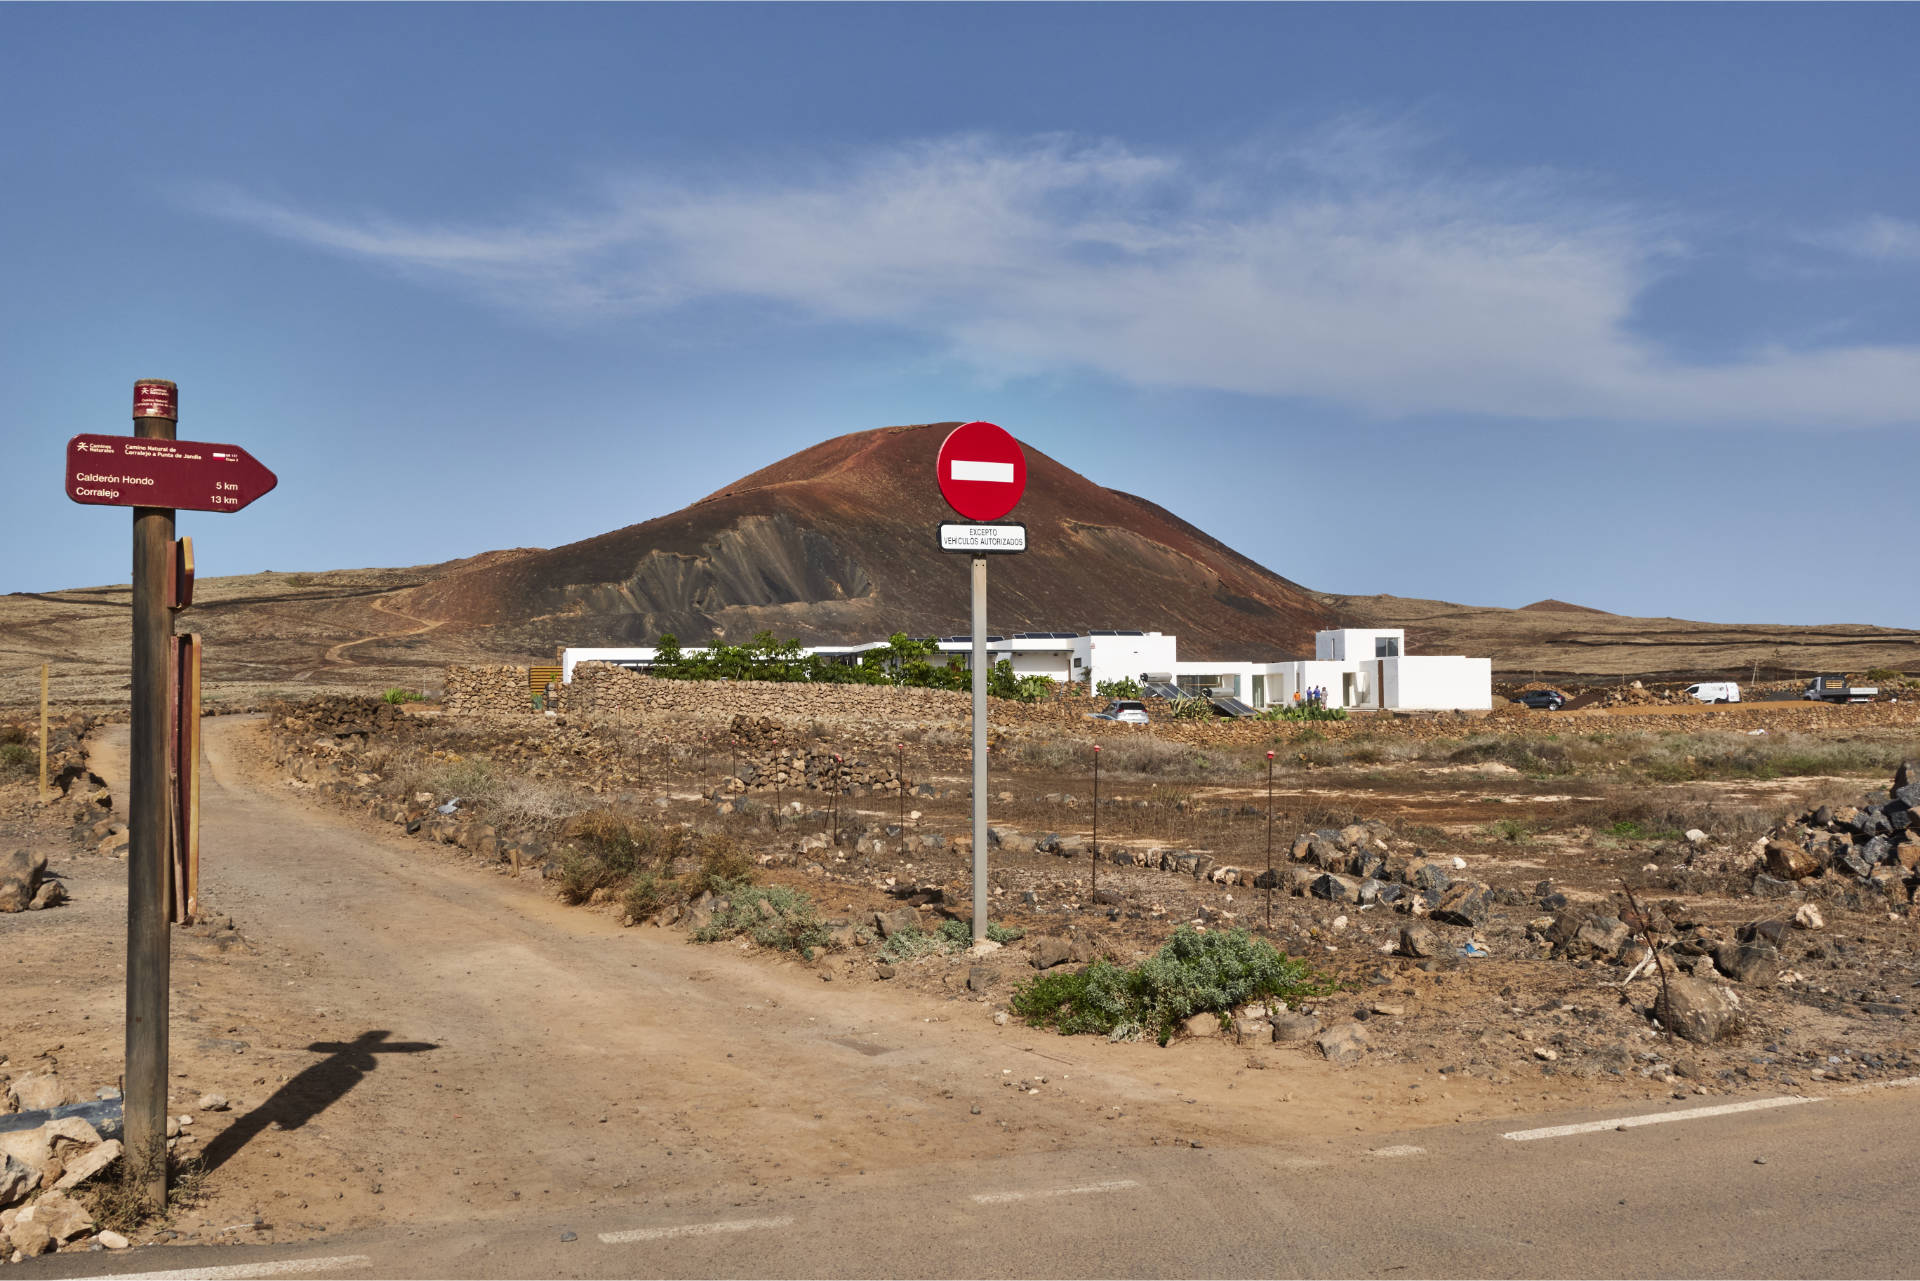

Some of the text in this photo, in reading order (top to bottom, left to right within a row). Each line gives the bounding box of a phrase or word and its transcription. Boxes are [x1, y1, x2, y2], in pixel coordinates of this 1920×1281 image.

[76, 472, 154, 486] Calderón Hondo
[216, 481, 238, 490] 5 km
[76, 487, 119, 499] Corralejo
[210, 496, 238, 504] 13 km
[969, 528, 998, 536] EXCEPTO
[980, 537, 1023, 546] AUTORIZADOS
